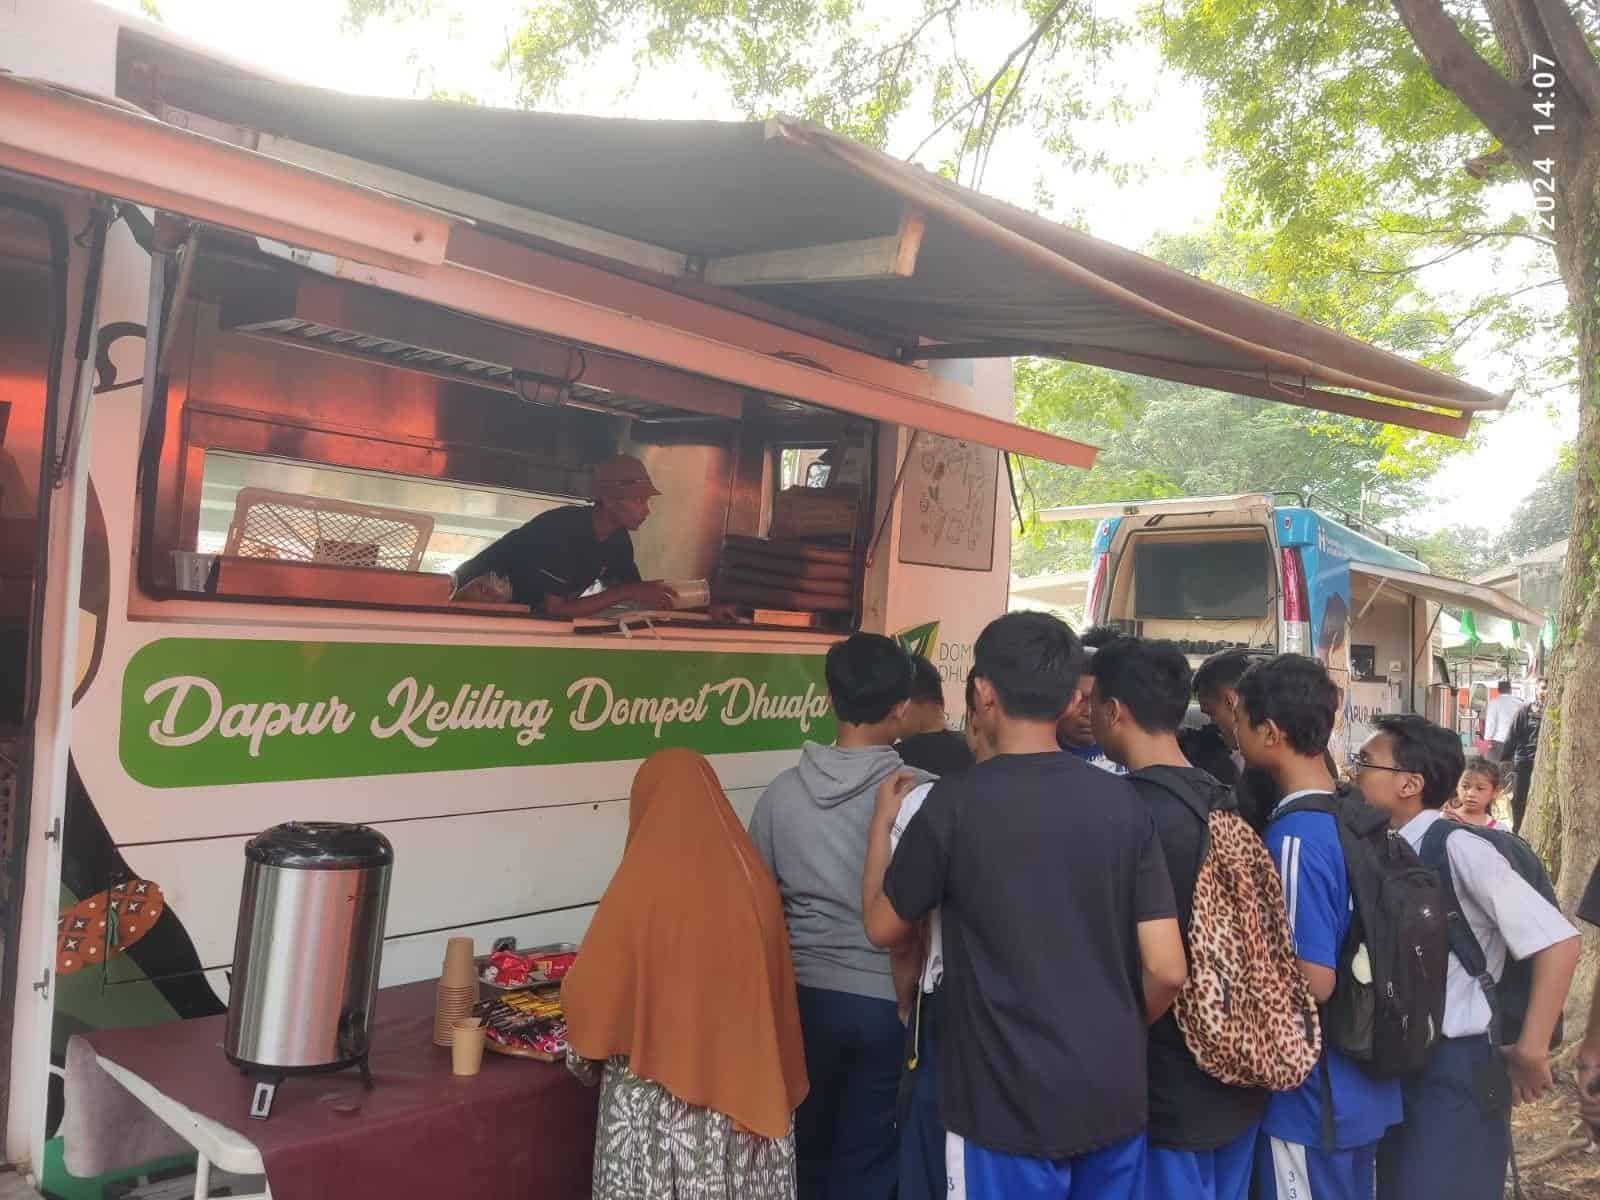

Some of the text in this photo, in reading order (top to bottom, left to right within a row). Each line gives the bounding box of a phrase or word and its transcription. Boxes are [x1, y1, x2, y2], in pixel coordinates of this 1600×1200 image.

[940, 643, 974, 661] DOM
[143, 675, 829, 757] Dapur Keliling Dompet Dhuafa
